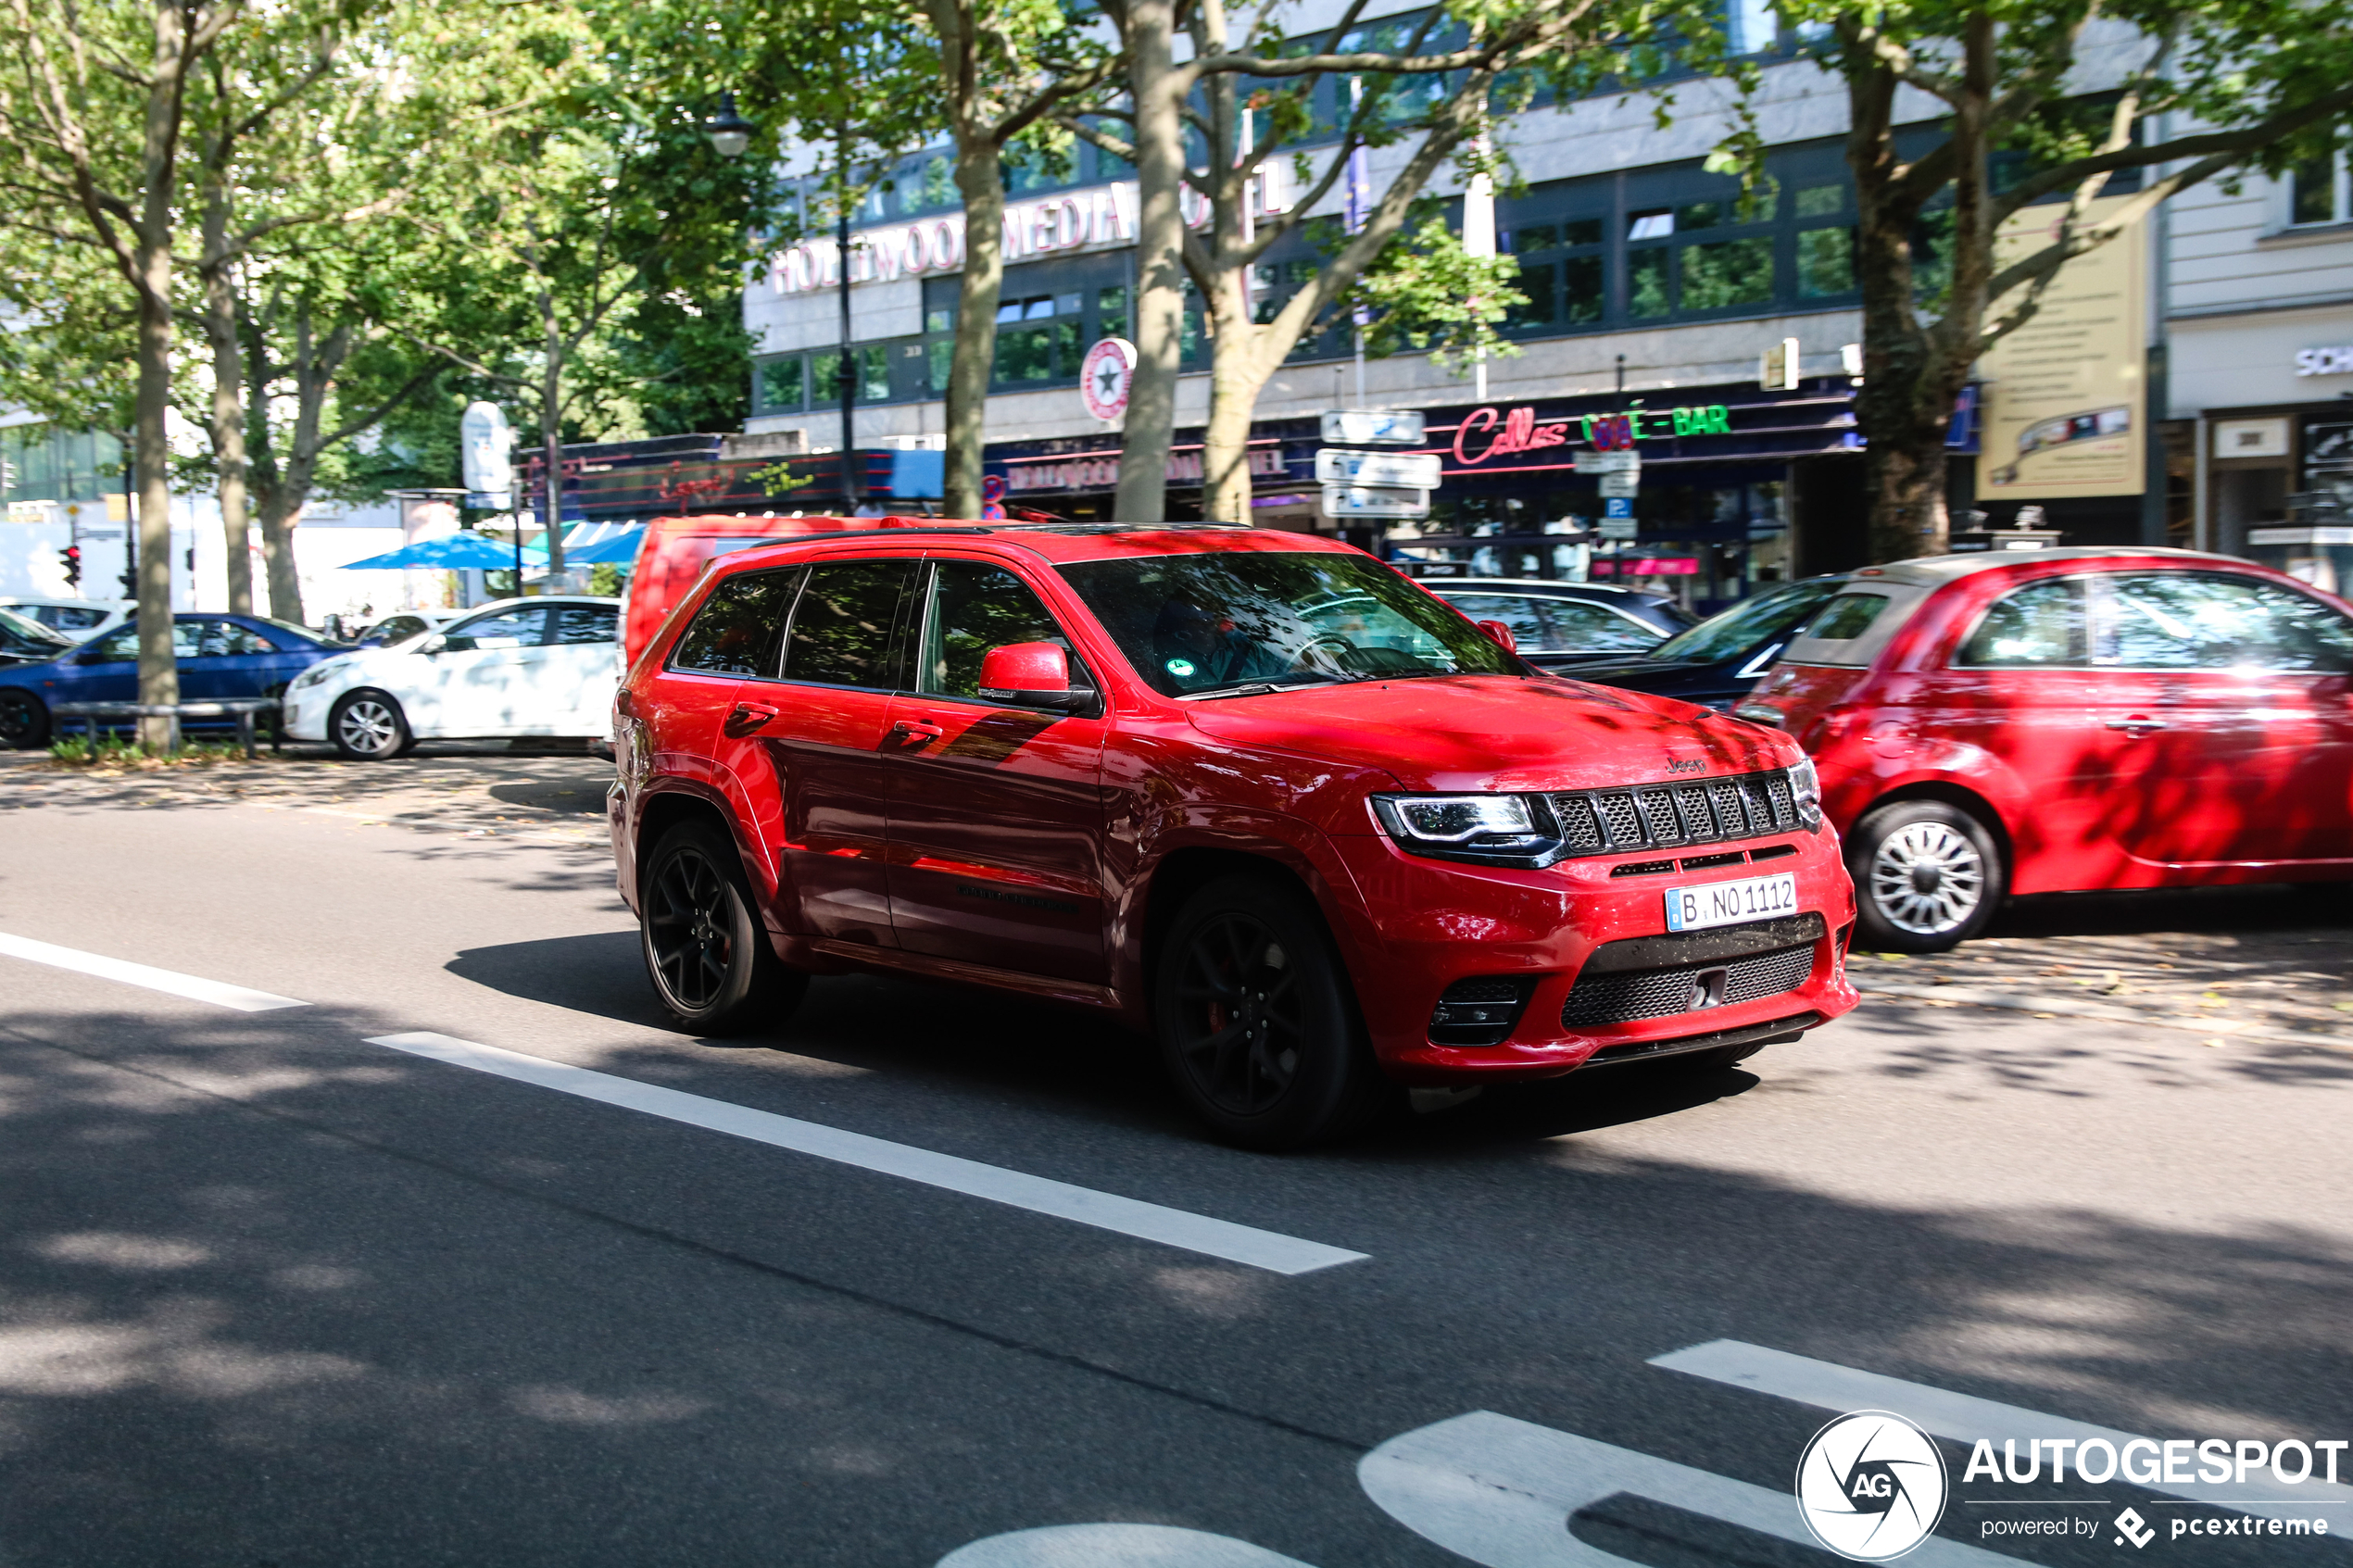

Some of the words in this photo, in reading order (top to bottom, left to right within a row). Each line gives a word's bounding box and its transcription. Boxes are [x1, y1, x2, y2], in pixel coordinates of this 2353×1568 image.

[773, 219, 967, 295] HOLYWOO
[1001, 182, 1133, 260] MEDIA
[1247, 449, 1291, 476] TEL
[1666, 757, 1706, 774] Jeep
[1683, 894, 1697, 922] B
[1713, 886, 1740, 919] NO
[1745, 880, 1793, 914] 1112
